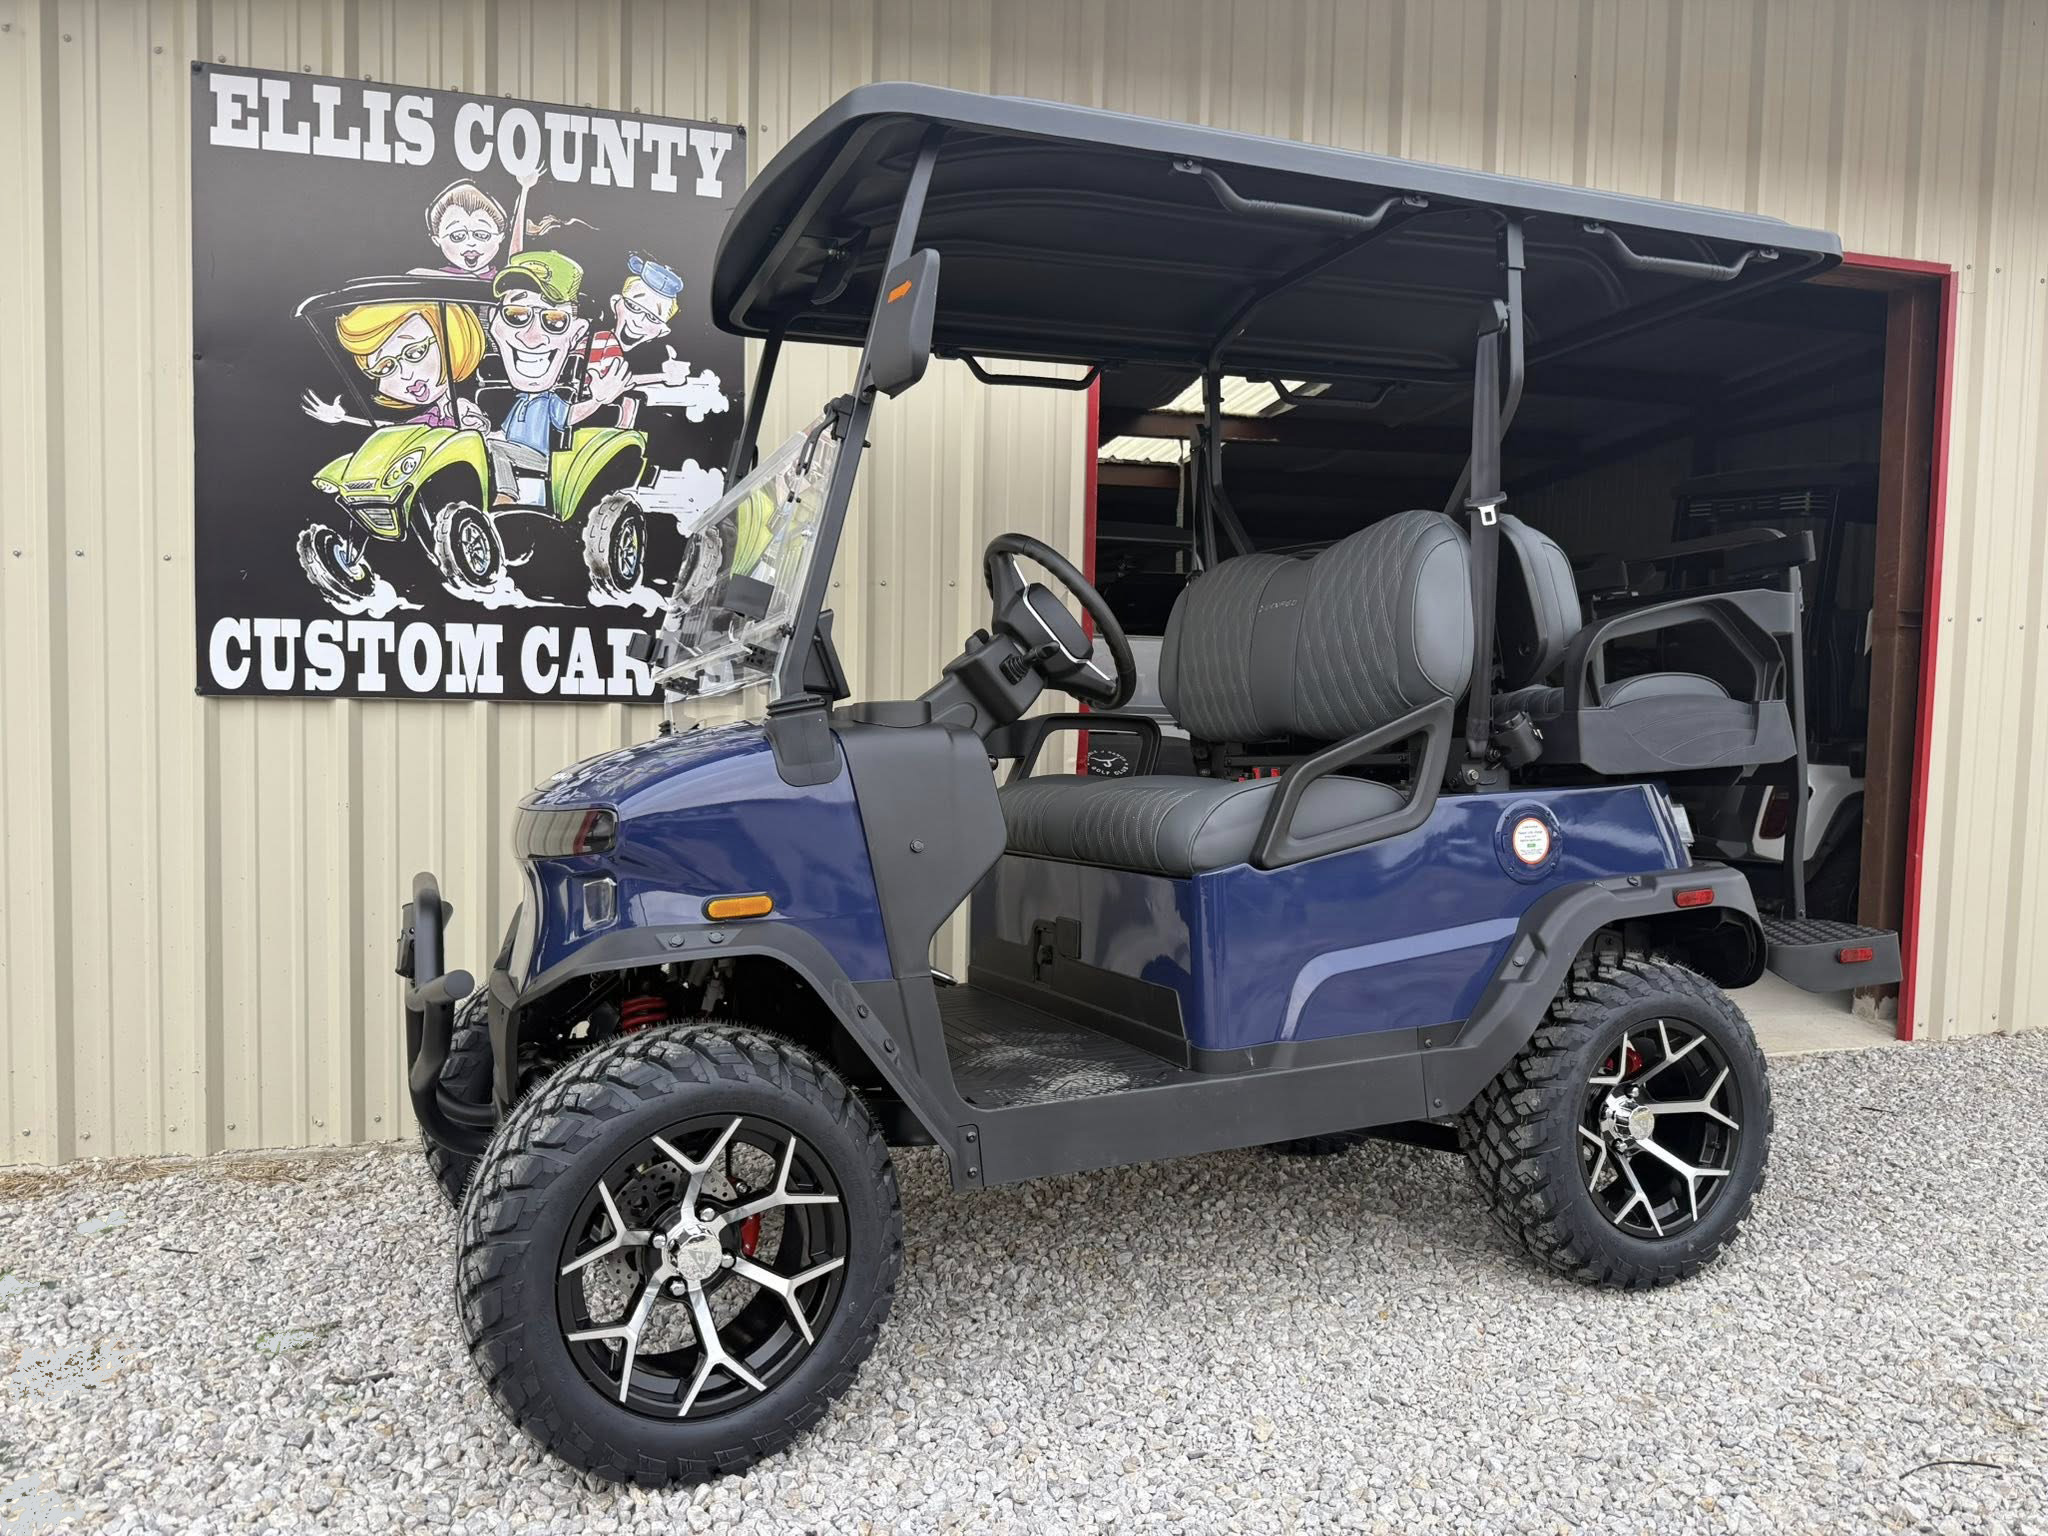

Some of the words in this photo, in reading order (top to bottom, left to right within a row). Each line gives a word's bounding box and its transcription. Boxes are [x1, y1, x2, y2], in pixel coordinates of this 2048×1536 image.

[209, 72, 436, 167] ELLIS
[453, 102, 733, 199] COUNTY
[209, 617, 504, 694] CUSTOM
[521, 625, 735, 696] CAR
[1091, 766, 1110, 776] GOLF
